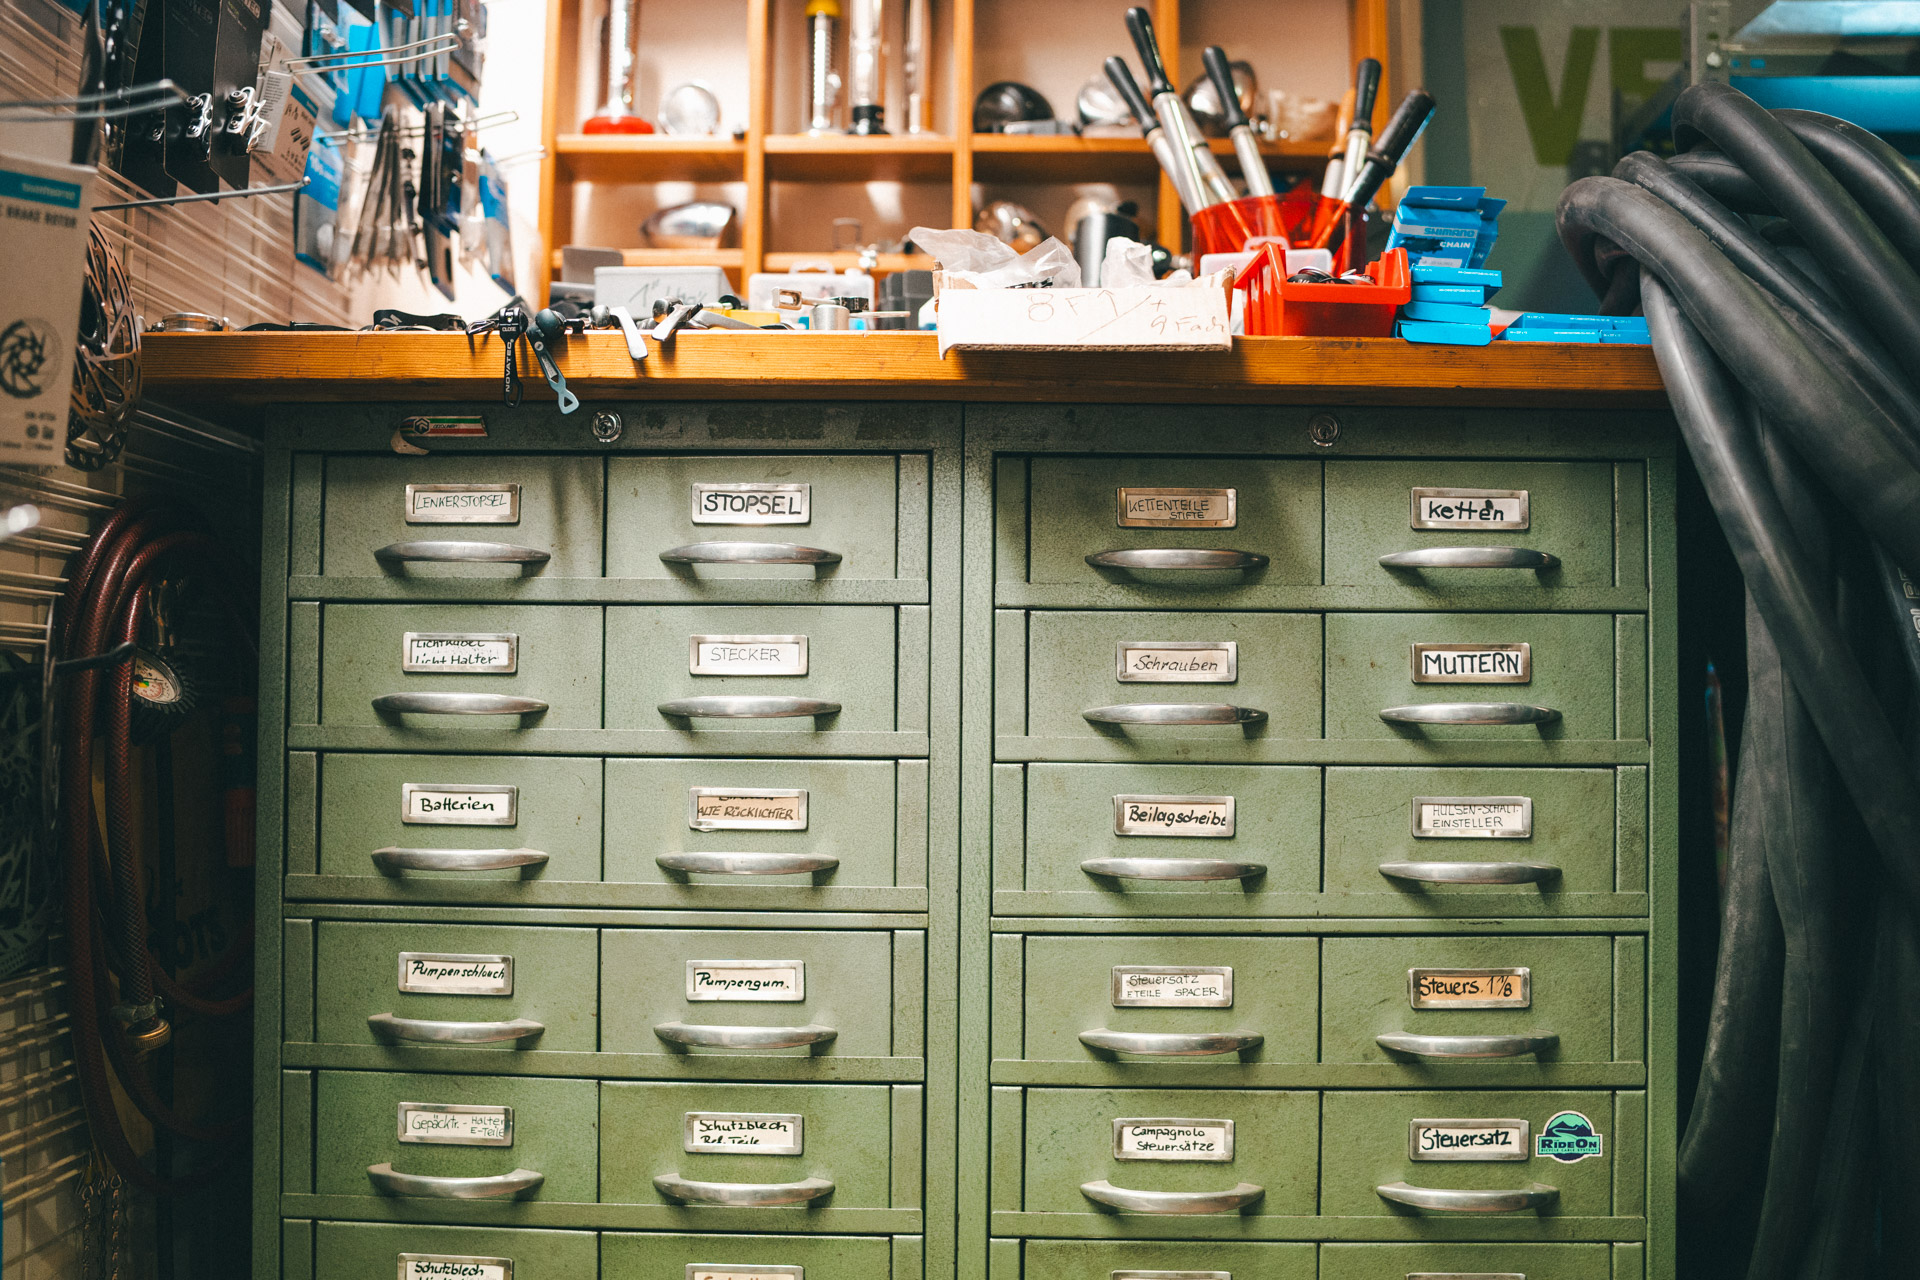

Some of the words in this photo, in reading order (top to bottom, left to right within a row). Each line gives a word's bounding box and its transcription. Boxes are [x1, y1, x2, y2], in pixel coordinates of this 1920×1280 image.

[1424, 227, 1476, 238] SHIMANO
[1440, 241, 1471, 249] CHAIN
[704, 493, 801, 515] STOPSEL
[1129, 498, 1210, 512] KETTENTEILE
[1169, 511, 1205, 520] STIFTE
[711, 647, 781, 661] STECKER
[1133, 654, 1218, 671] Schrauben
[420, 796, 494, 812] Batterien
[1432, 817, 1503, 828] EINSTELLER
[696, 972, 790, 991] Pumpengum.
[1129, 974, 1199, 987] Steuersatz
[1419, 976, 1484, 996] Steuers.
[1174, 987, 1220, 997] SPACER
[699, 1120, 788, 1132] Schutzblech
[1131, 1126, 1205, 1140] Campagnolo
[1421, 1127, 1512, 1150] Steuersatz
[1136, 1141, 1215, 1151] Steuersätze
[415, 1260, 484, 1276] Schutzblech
